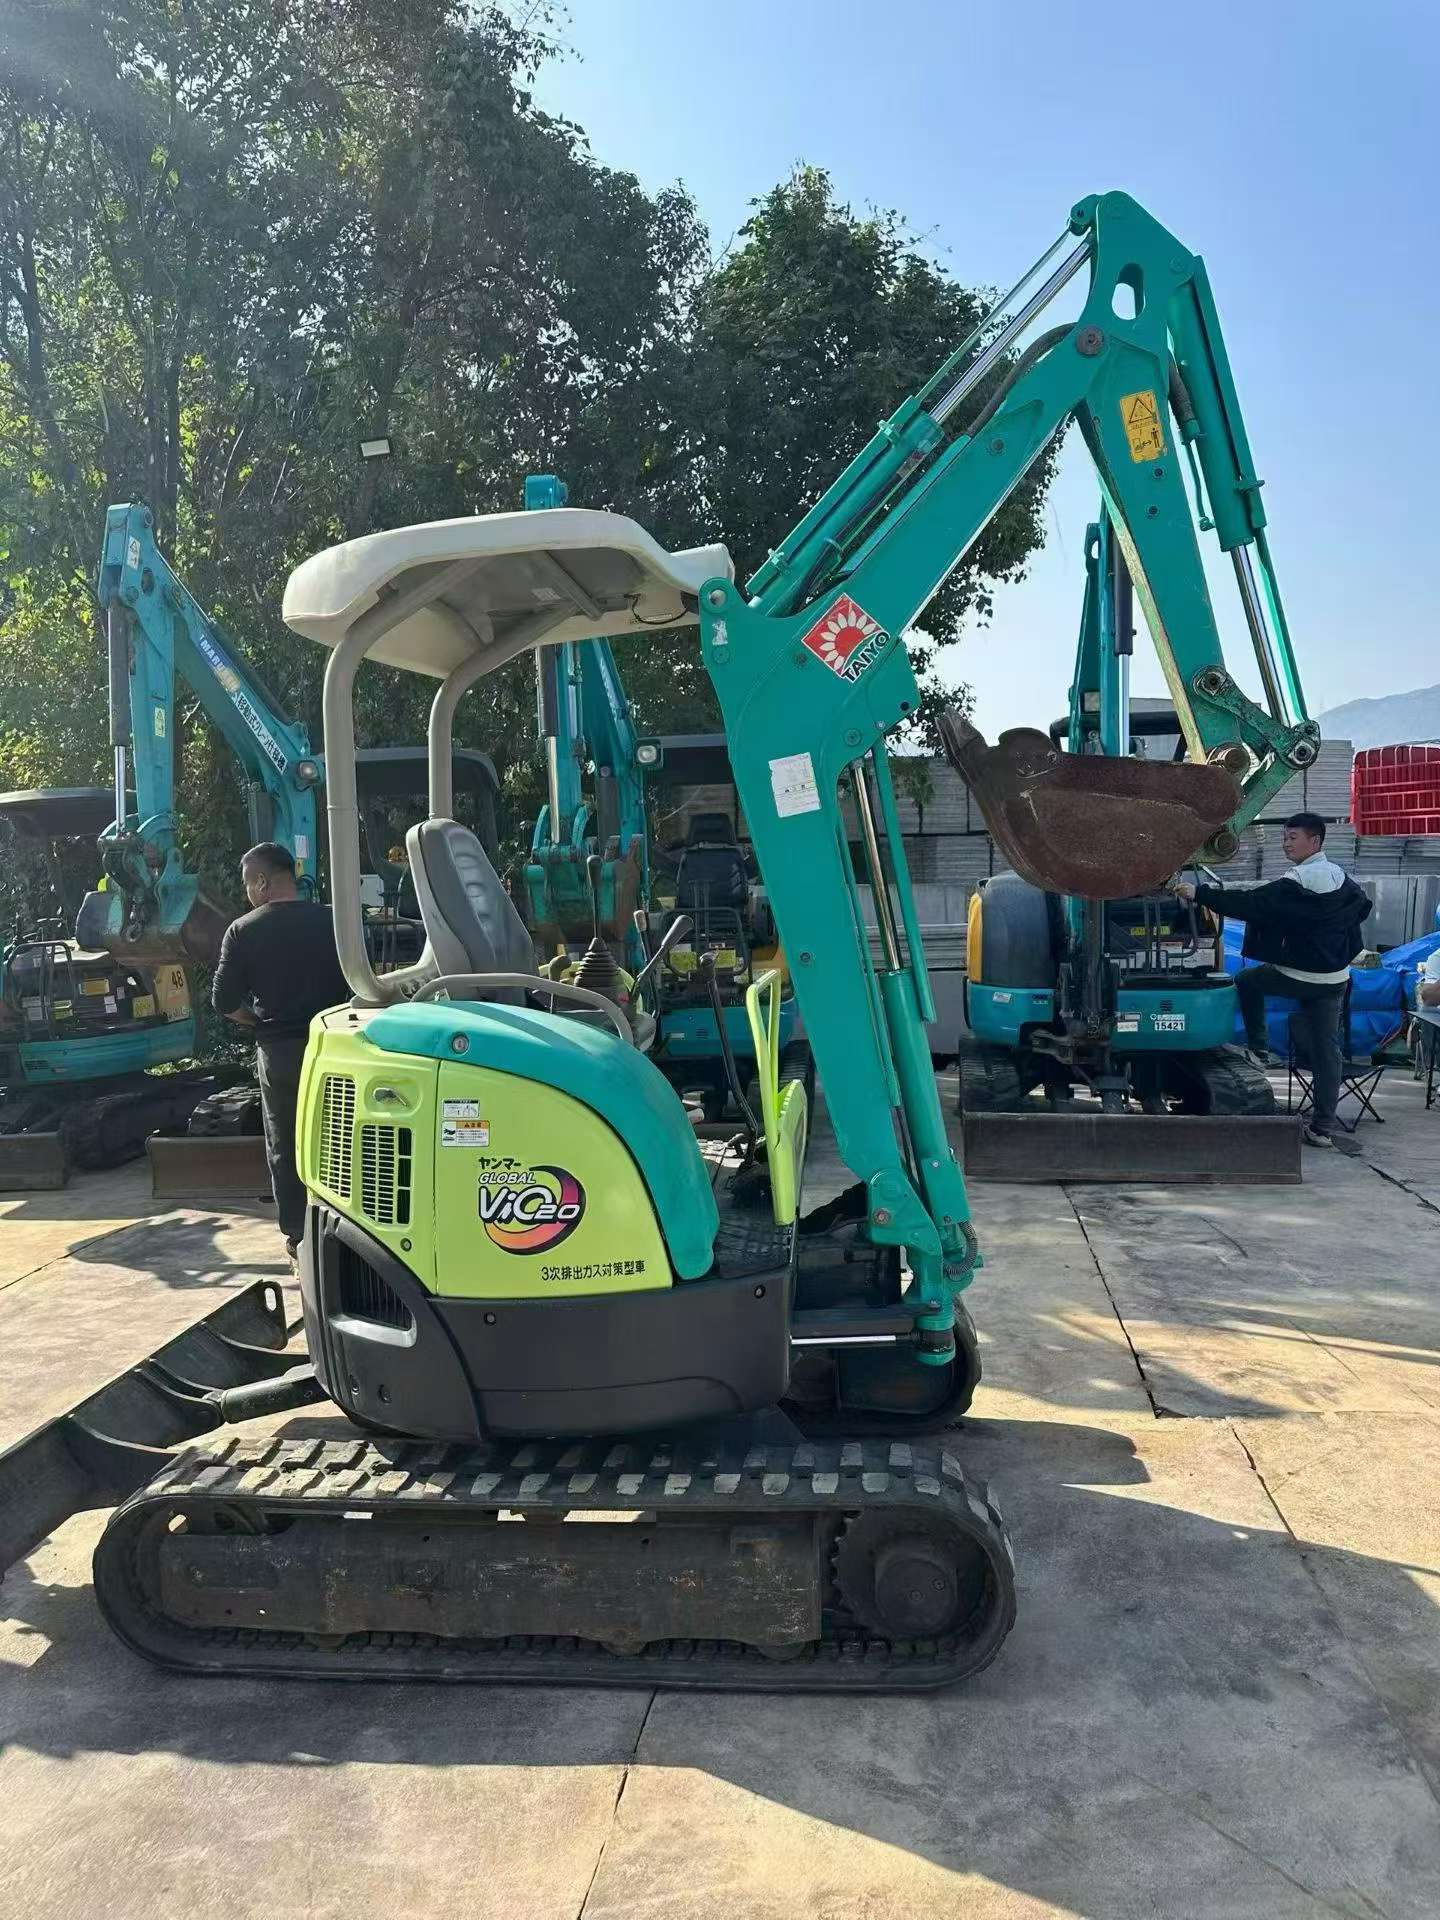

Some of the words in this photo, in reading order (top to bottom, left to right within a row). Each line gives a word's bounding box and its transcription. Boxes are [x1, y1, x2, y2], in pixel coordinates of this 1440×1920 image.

[840, 630, 890, 683] TAIYO
[171, 970, 184, 989] 48
[1155, 1021, 1184, 1030] 15421
[479, 1156, 521, 1170] ヤンマー
[478, 1172, 536, 1184] GLOBAL
